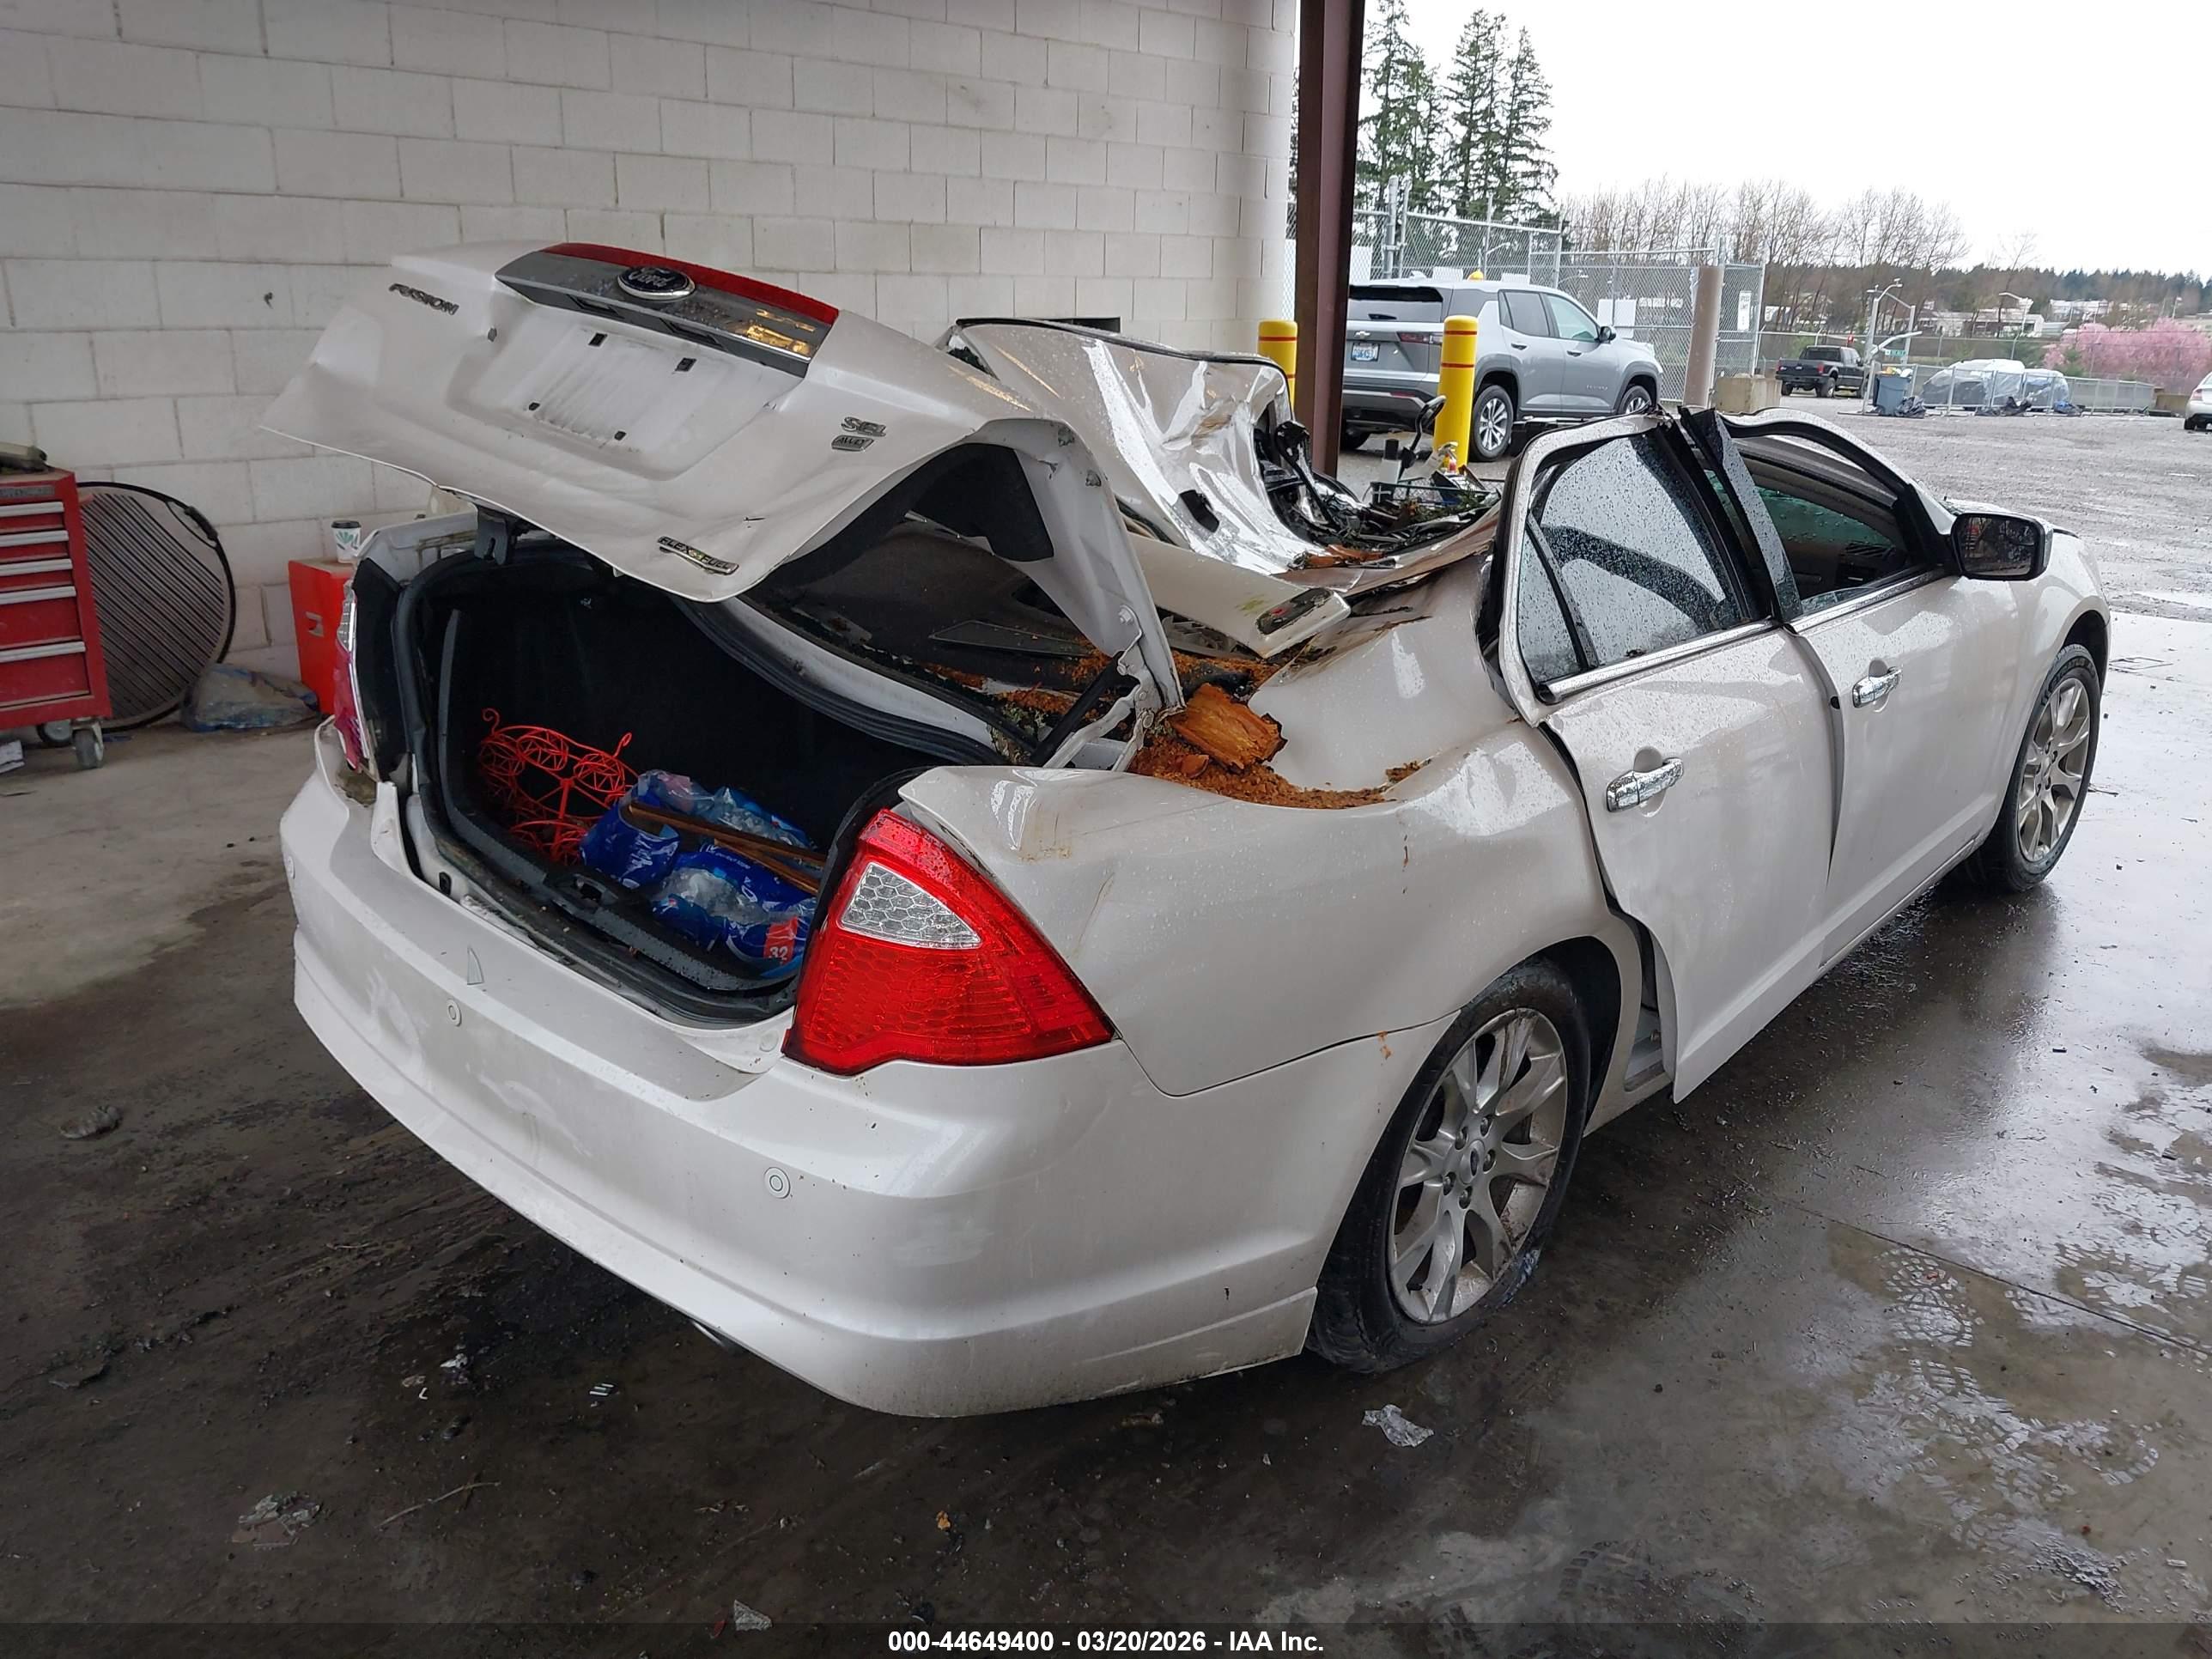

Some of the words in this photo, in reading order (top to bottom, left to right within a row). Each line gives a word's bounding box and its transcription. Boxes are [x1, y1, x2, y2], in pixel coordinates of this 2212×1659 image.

[628, 268, 676, 288] Ford
[388, 283, 459, 315] FUSION
[841, 416, 887, 437] SEL
[835, 435, 870, 448] AWD
[659, 536, 690, 556] FLEX
[700, 554, 730, 570] FUEL
